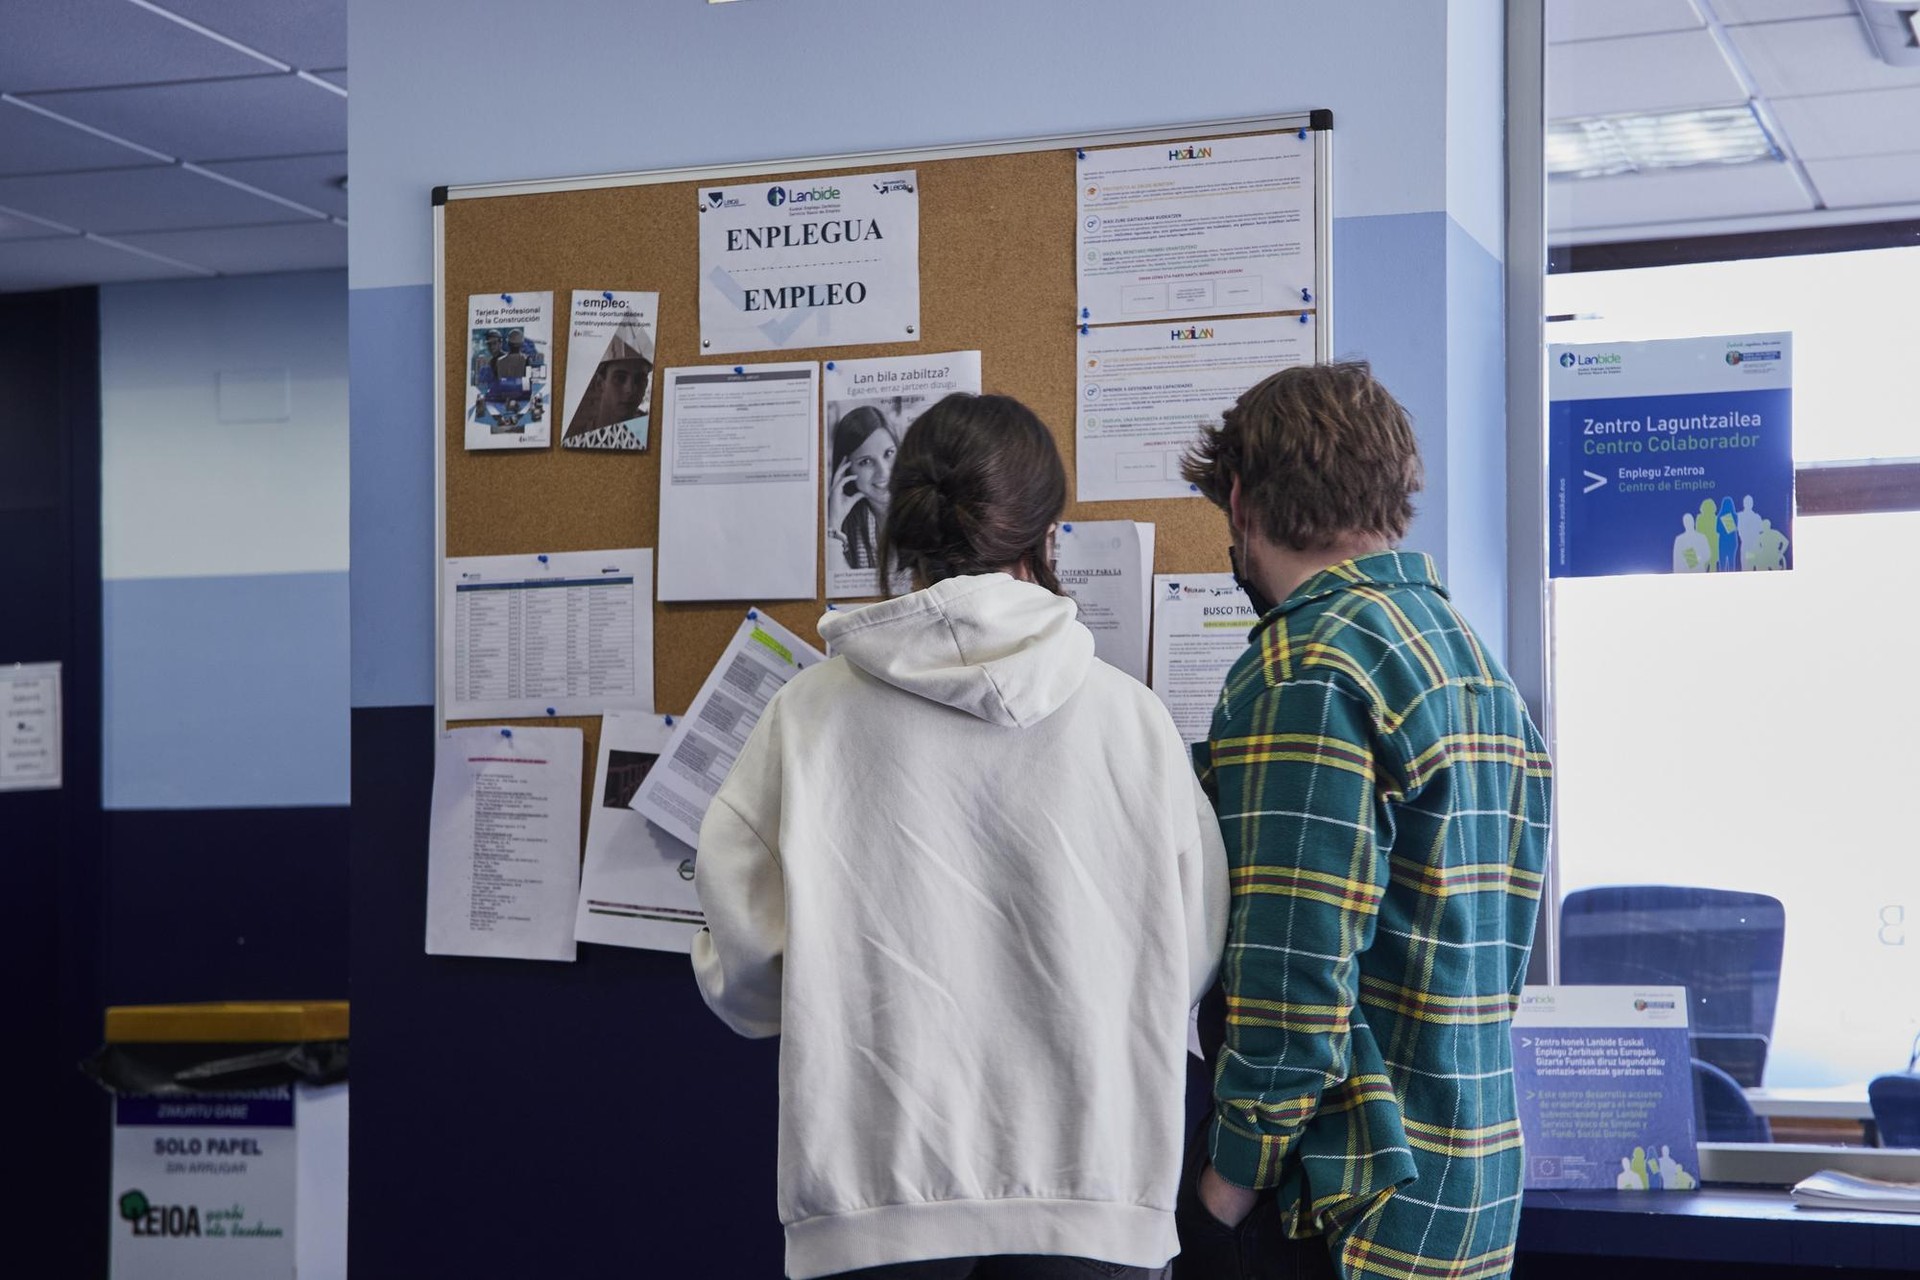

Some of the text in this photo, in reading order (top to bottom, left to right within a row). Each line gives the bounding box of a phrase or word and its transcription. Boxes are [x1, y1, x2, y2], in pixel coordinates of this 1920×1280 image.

[789, 186, 841, 204] Lanbide
[726, 218, 883, 252] ENPLEGUA
[743, 281, 867, 312] EMPLEO
[476, 306, 541, 317] Tarjeta Profesional
[1578, 353, 1621, 366] Lanbide
[854, 367, 950, 384] Lan bila zabiltza?
[1583, 411, 1762, 436] Zentro Laguntzailea
[1583, 432, 1760, 455] Centro Colaborador
[1618, 466, 1705, 481] Enplegu Zentroa
[1618, 479, 1716, 494] Centro de Empleo
[1203, 606, 1234, 616] BUSCO
[1535, 1037, 1644, 1046] Zentro honek Lanbide Euskal
[1535, 1048, 1567, 1058] Enplegu
[1606, 1048, 1618, 1056] eta
[1620, 1047, 1657, 1058] Europako
[1536, 1057, 1666, 1068] Gizarte Funtsak diruz lagundutako
[1612, 1068, 1645, 1078] garatzen
[154, 1138, 263, 1156] SOLO PAPEL
[132, 1205, 201, 1237] LEIOA
